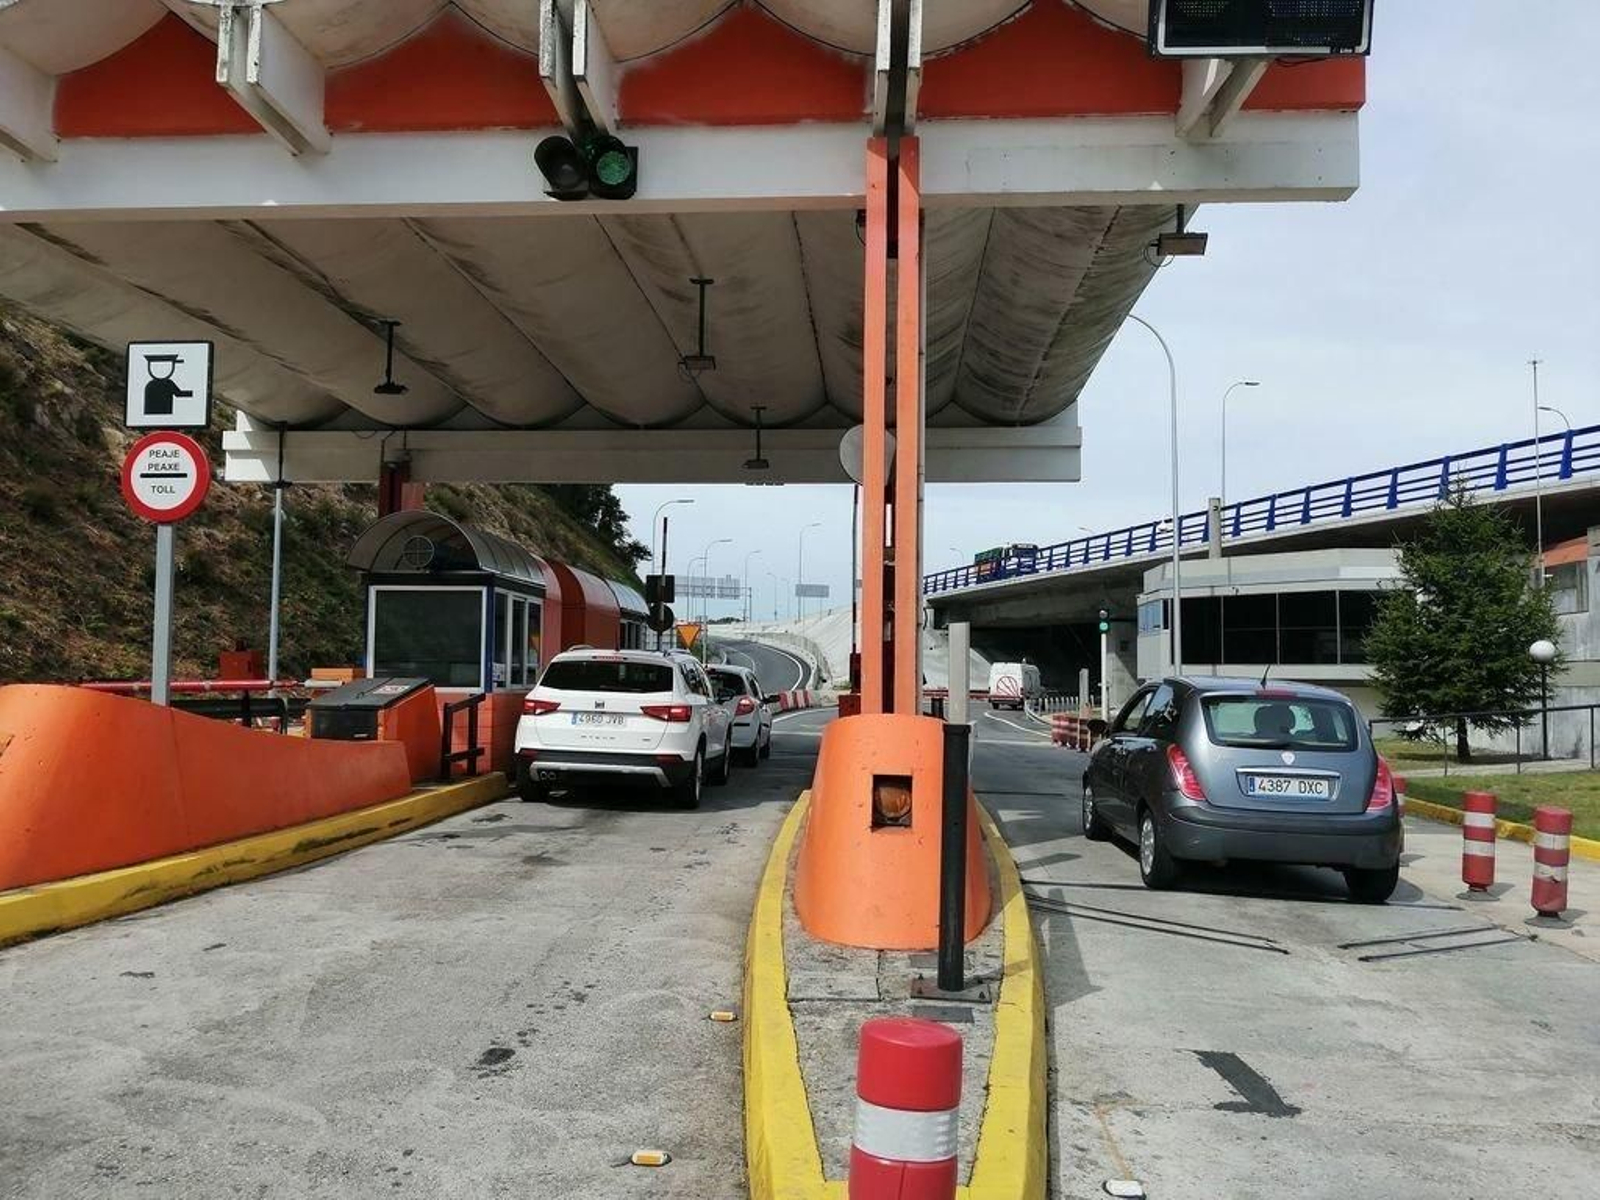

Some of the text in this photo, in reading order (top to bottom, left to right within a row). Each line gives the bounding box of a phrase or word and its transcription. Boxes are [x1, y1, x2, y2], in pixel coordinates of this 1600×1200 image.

[149, 449, 180, 459] PEAJE
[147, 463, 181, 472] PEAXE
[151, 485, 176, 495] TOLL
[1258, 778, 1323, 795] 4387 DXC
